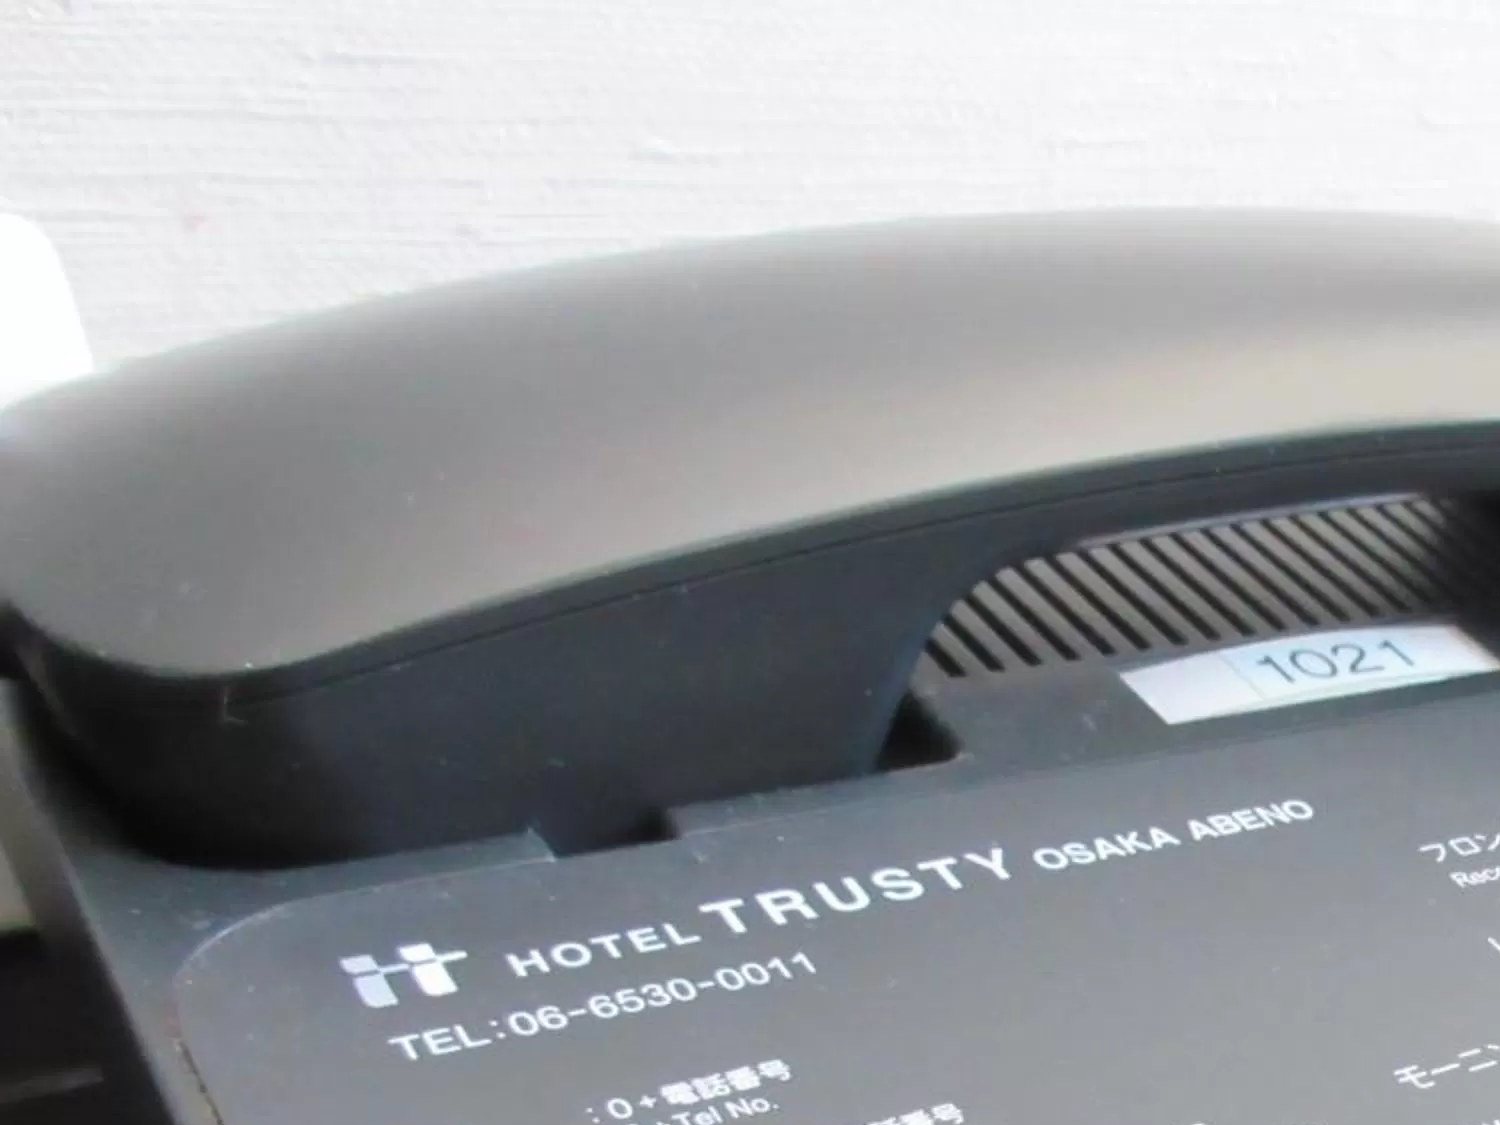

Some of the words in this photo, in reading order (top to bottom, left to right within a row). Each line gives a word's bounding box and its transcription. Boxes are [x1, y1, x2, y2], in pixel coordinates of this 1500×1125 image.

[1257, 639, 1415, 685] 1021
[506, 922, 701, 977] HOTEL
[699, 847, 1010, 933] TRUSTY
[1032, 826, 1179, 870] OSAKA
[1187, 798, 1314, 842] ABENO
[724, 1096, 779, 1119] No.
